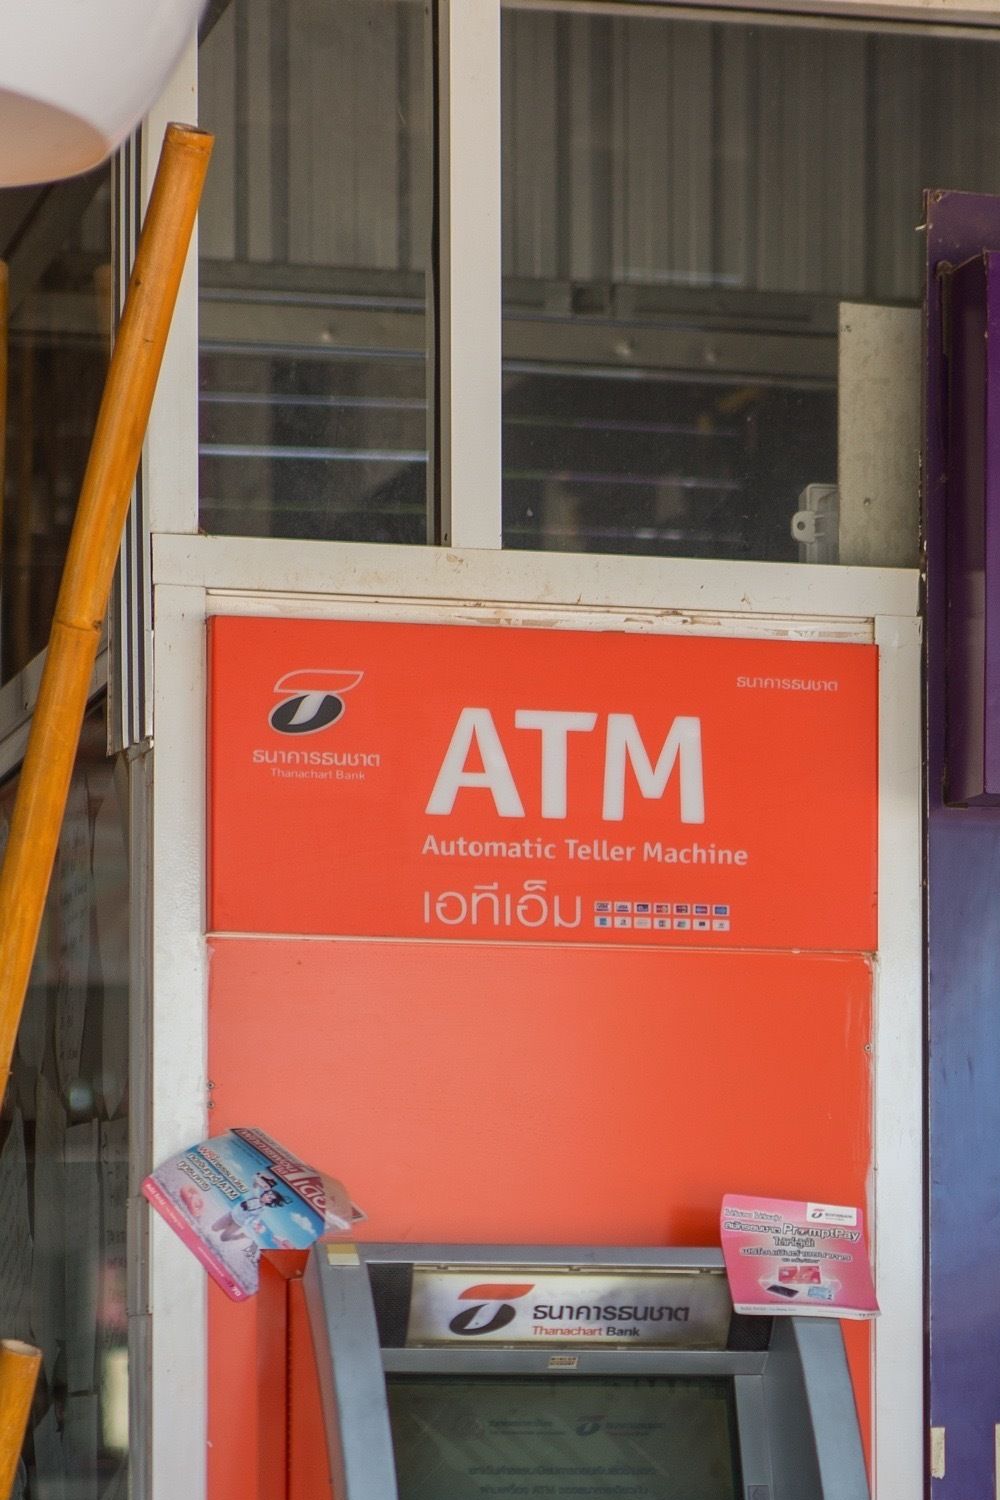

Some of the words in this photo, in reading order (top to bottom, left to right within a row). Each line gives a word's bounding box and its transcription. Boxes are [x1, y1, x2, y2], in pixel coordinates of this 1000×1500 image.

[736, 675, 839, 692] ธนาคารธนชาต
[252, 748, 381, 768] ธนาคารธนชาต
[425, 707, 706, 824] ATM
[271, 767, 333, 780] Thanachart
[336, 769, 366, 781] Bank
[421, 833, 557, 861] Automatic
[565, 837, 636, 863] Teller
[643, 840, 749, 867] Machine
[423, 879, 582, 929] เอทีเอ็ม
[533, 1305, 690, 1323] ธนาคารธนชาต
[532, 1325, 603, 1337] Thanachart
[606, 1327, 640, 1338] Bank
